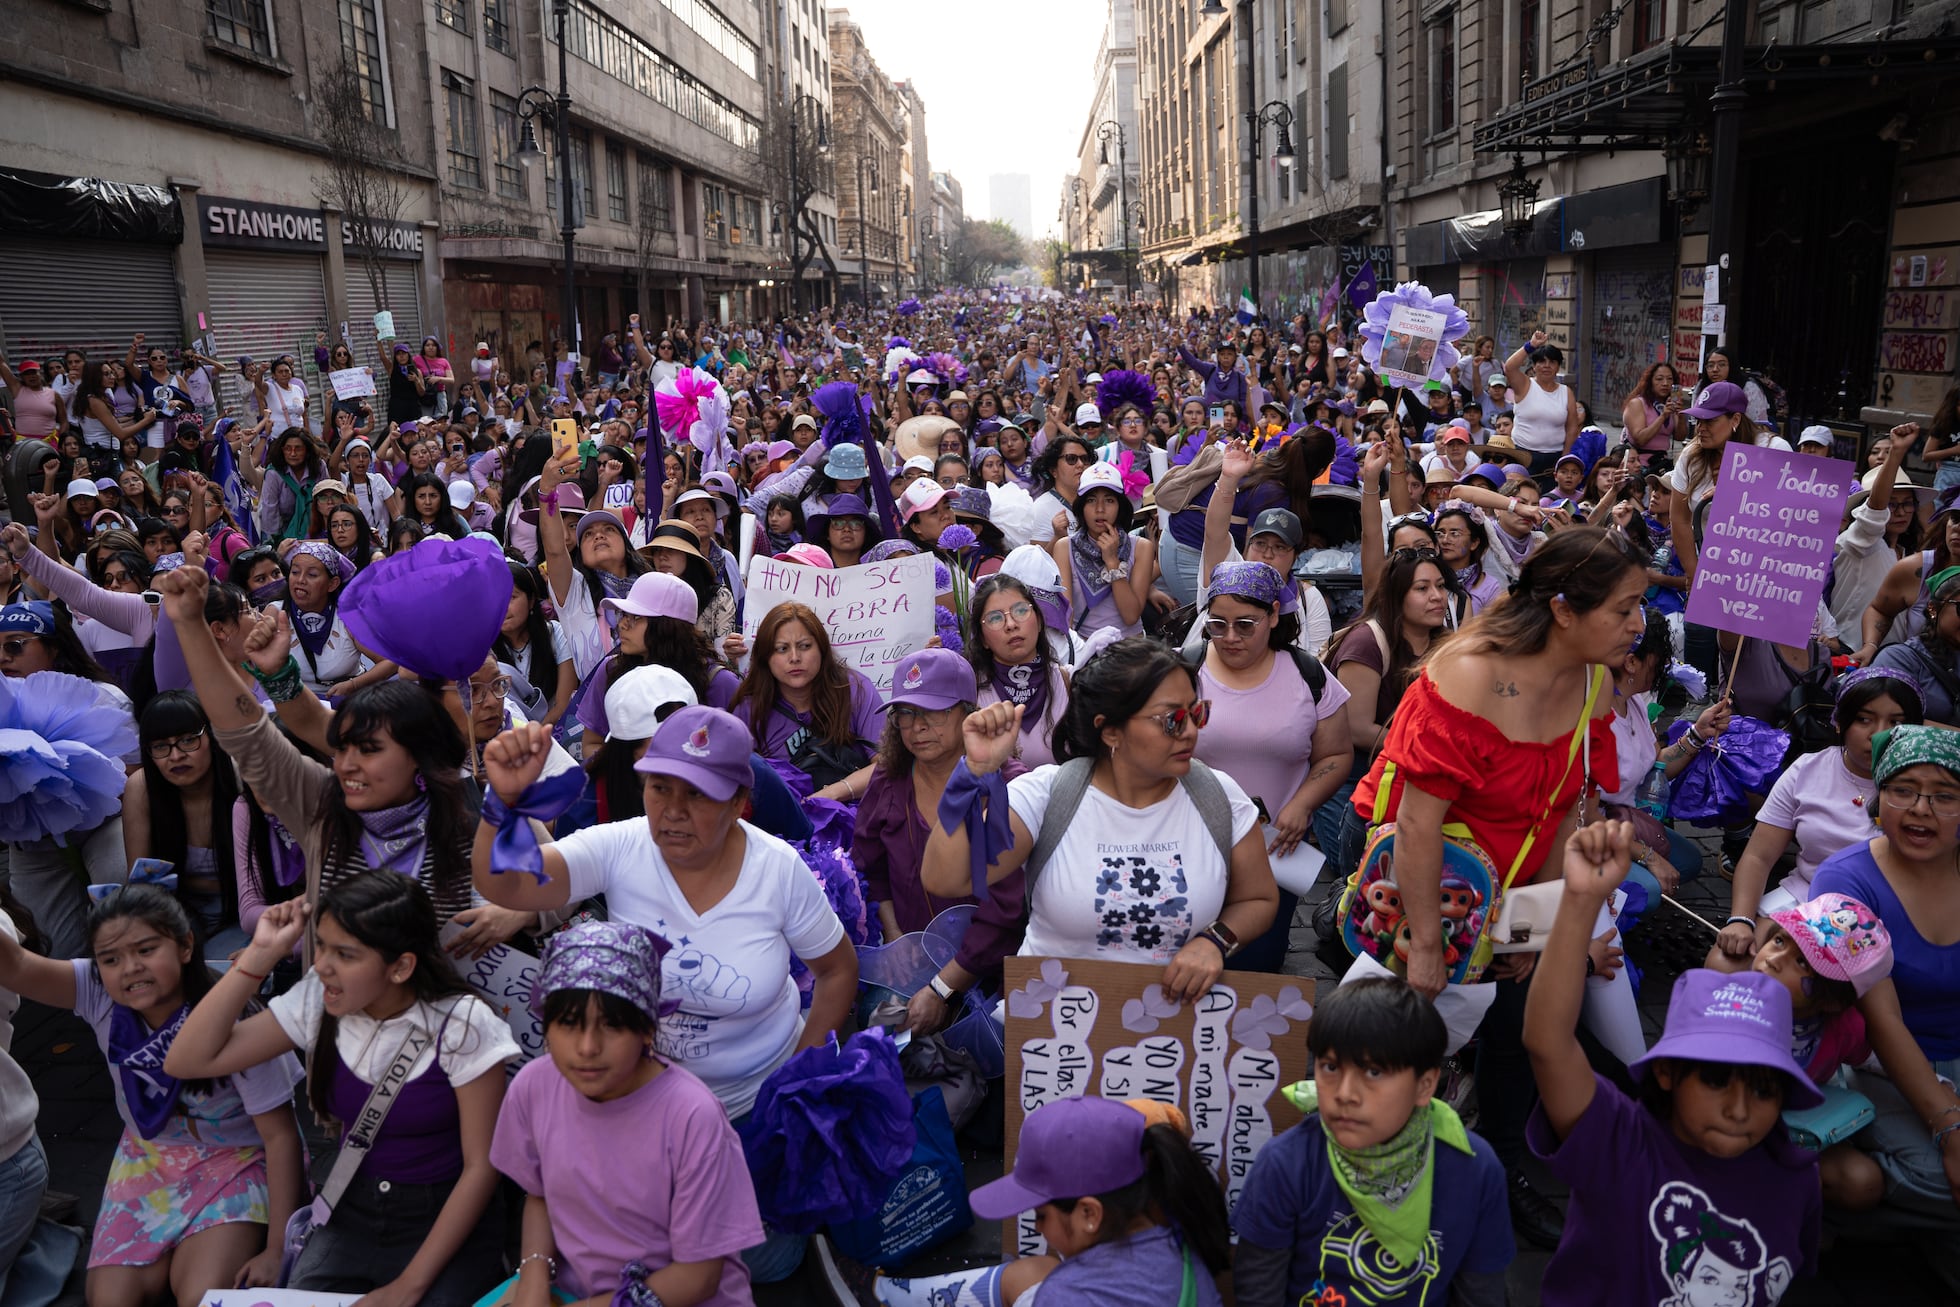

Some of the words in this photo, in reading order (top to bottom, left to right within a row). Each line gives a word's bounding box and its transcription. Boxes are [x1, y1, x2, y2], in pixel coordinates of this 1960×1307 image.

[1528, 77, 1560, 102] EDIFICIO
[1563, 65, 1587, 88] PARIS
[207, 206, 324, 243] STANHOME
[1399, 321, 1434, 334] PEDERASTA
[1885, 351, 1946, 371] VIOLADOR
[1729, 452, 1764, 485] Por
[1776, 461, 1840, 499] todas
[607, 484, 634, 504] TOD
[1738, 491, 1771, 518] las
[1778, 506, 1820, 528] que
[1712, 515, 1824, 553] abrazaron
[761, 562, 801, 594] HOY
[815, 575, 841, 598] NO
[864, 566, 902, 590] SE
[1705, 546, 1722, 561] a
[1727, 548, 1753, 566] su
[1760, 555, 1826, 583] mamá
[1696, 568, 1732, 590] por
[1735, 572, 1803, 605] última
[1719, 597, 1765, 622] vez.
[831, 626, 884, 643] forma
[859, 646, 875, 663] la
[1097, 843, 1139, 854] FLOWER
[1141, 840, 1180, 853] MARKET
[1200, 991, 1234, 1014] A
[1712, 990, 1764, 1009] Mujer
[1724, 982, 1753, 994] Ser
[1060, 990, 1095, 1030] Por
[409, 1038, 425, 1053] Y
[1022, 1043, 1050, 1058] Y
[1199, 1025, 1220, 1052] mi
[1106, 1053, 1133, 1067] Y
[1145, 1040, 1176, 1069] YO
[377, 1054, 413, 1098] LOLA
[1054, 1044, 1087, 1097] ellas,
[1237, 1054, 1276, 1088] Mi
[1023, 1069, 1047, 1112] LAS
[1194, 1063, 1223, 1130] madre
[348, 1107, 382, 1150] BIMA
